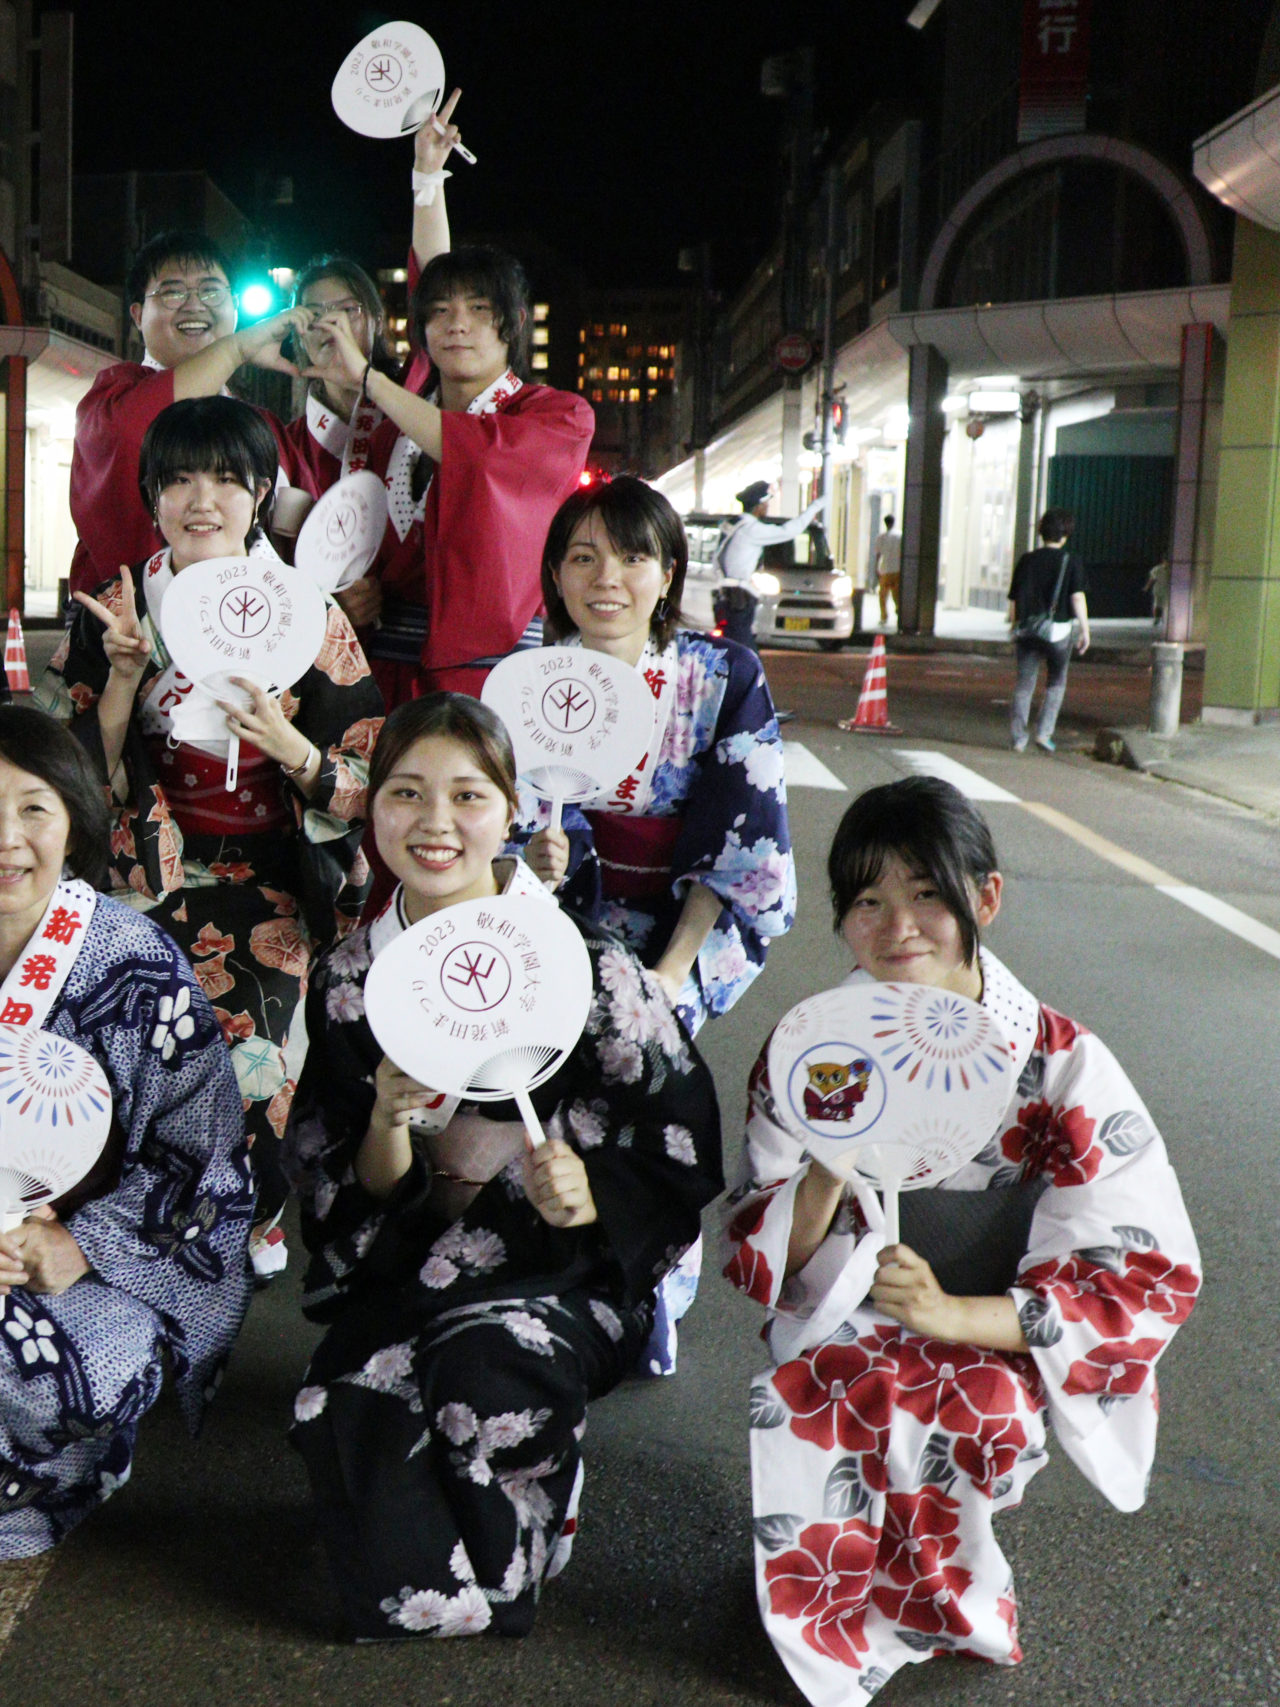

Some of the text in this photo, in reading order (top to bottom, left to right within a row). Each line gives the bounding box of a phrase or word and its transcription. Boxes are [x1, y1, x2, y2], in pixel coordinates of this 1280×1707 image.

[1038, 0, 1078, 54] 行
[217, 565, 248, 584] 2023
[262, 570, 293, 653] 敬和学園大学
[540, 656, 574, 675] 2023
[588, 663, 619, 750] 敬和学園大学
[412, 911, 542, 1041] 2023 敬和学園大学 新発田まつり
